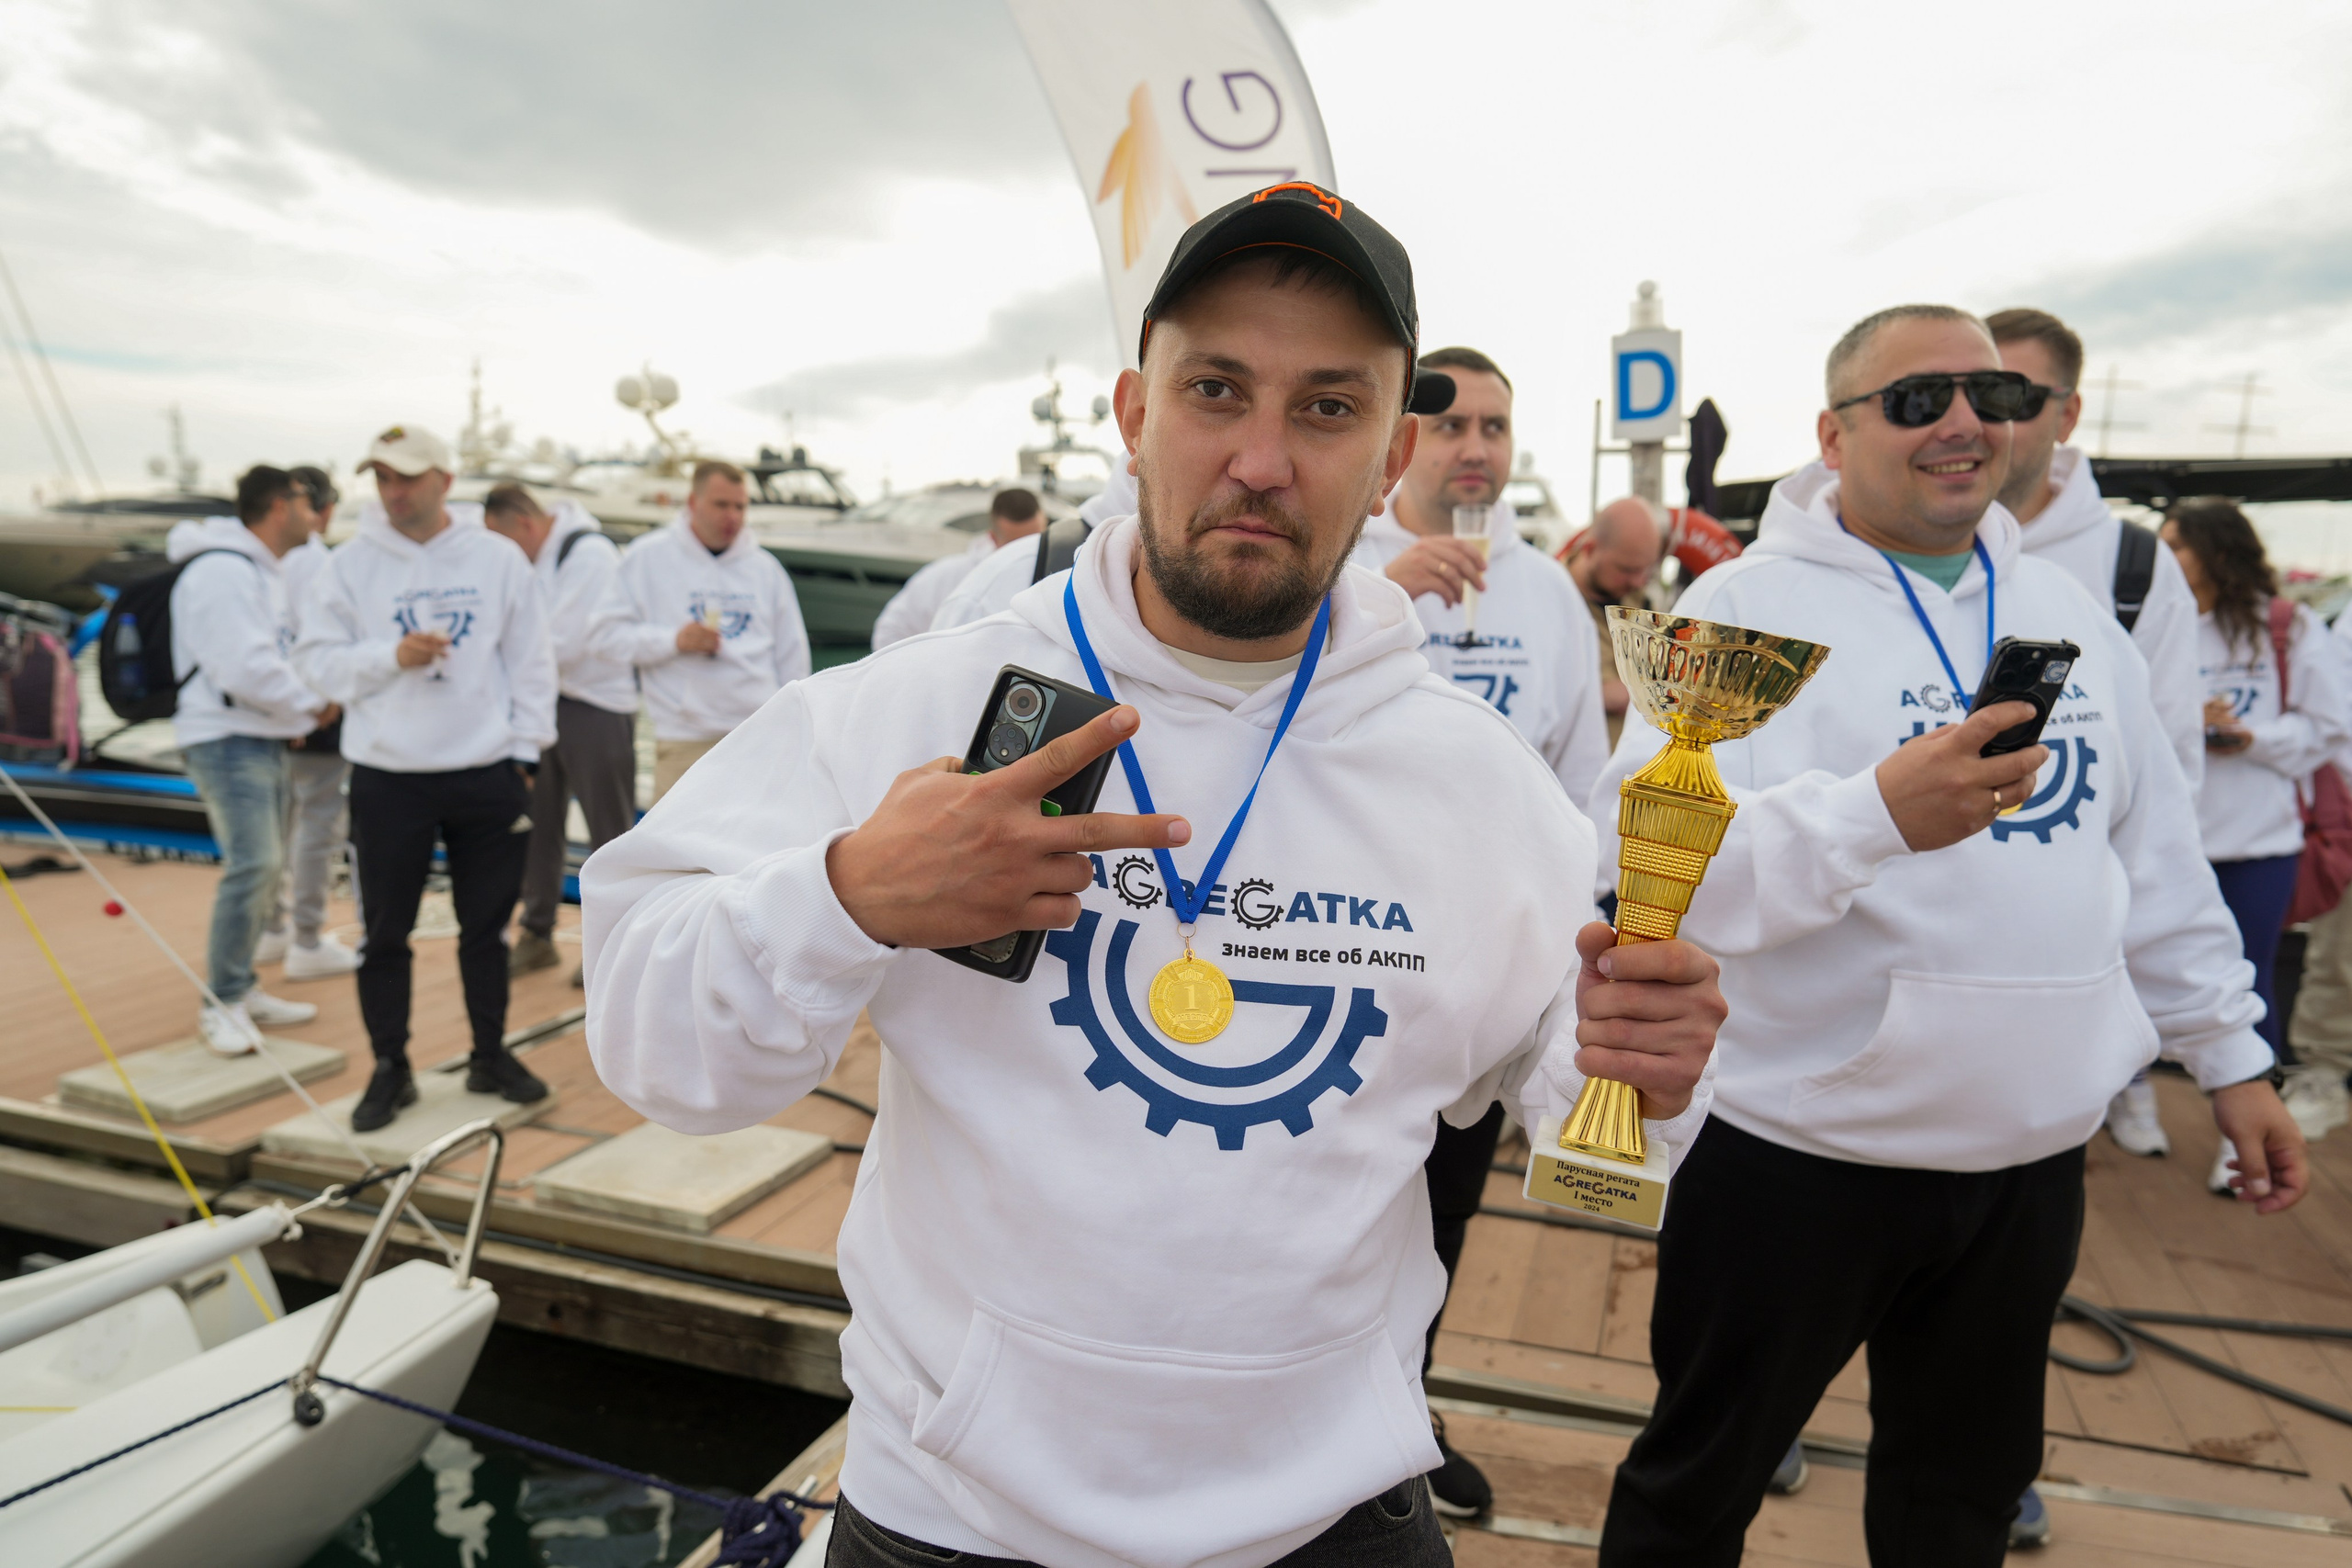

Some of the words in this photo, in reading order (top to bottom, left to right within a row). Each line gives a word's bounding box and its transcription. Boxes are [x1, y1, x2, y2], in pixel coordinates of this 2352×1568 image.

[1618, 351, 1676, 421] D
[1295, 949, 1331, 964] все
[1337, 948, 1363, 965] об
[1367, 950, 1425, 973] АКПП
[1556, 1160, 1605, 1179] Парусная
[1605, 1173, 1640, 1188] регата
[1554, 1174, 1637, 1201] AGREGATKA
[1580, 1193, 1613, 1208] место
[1583, 1202, 1600, 1213] 2024
